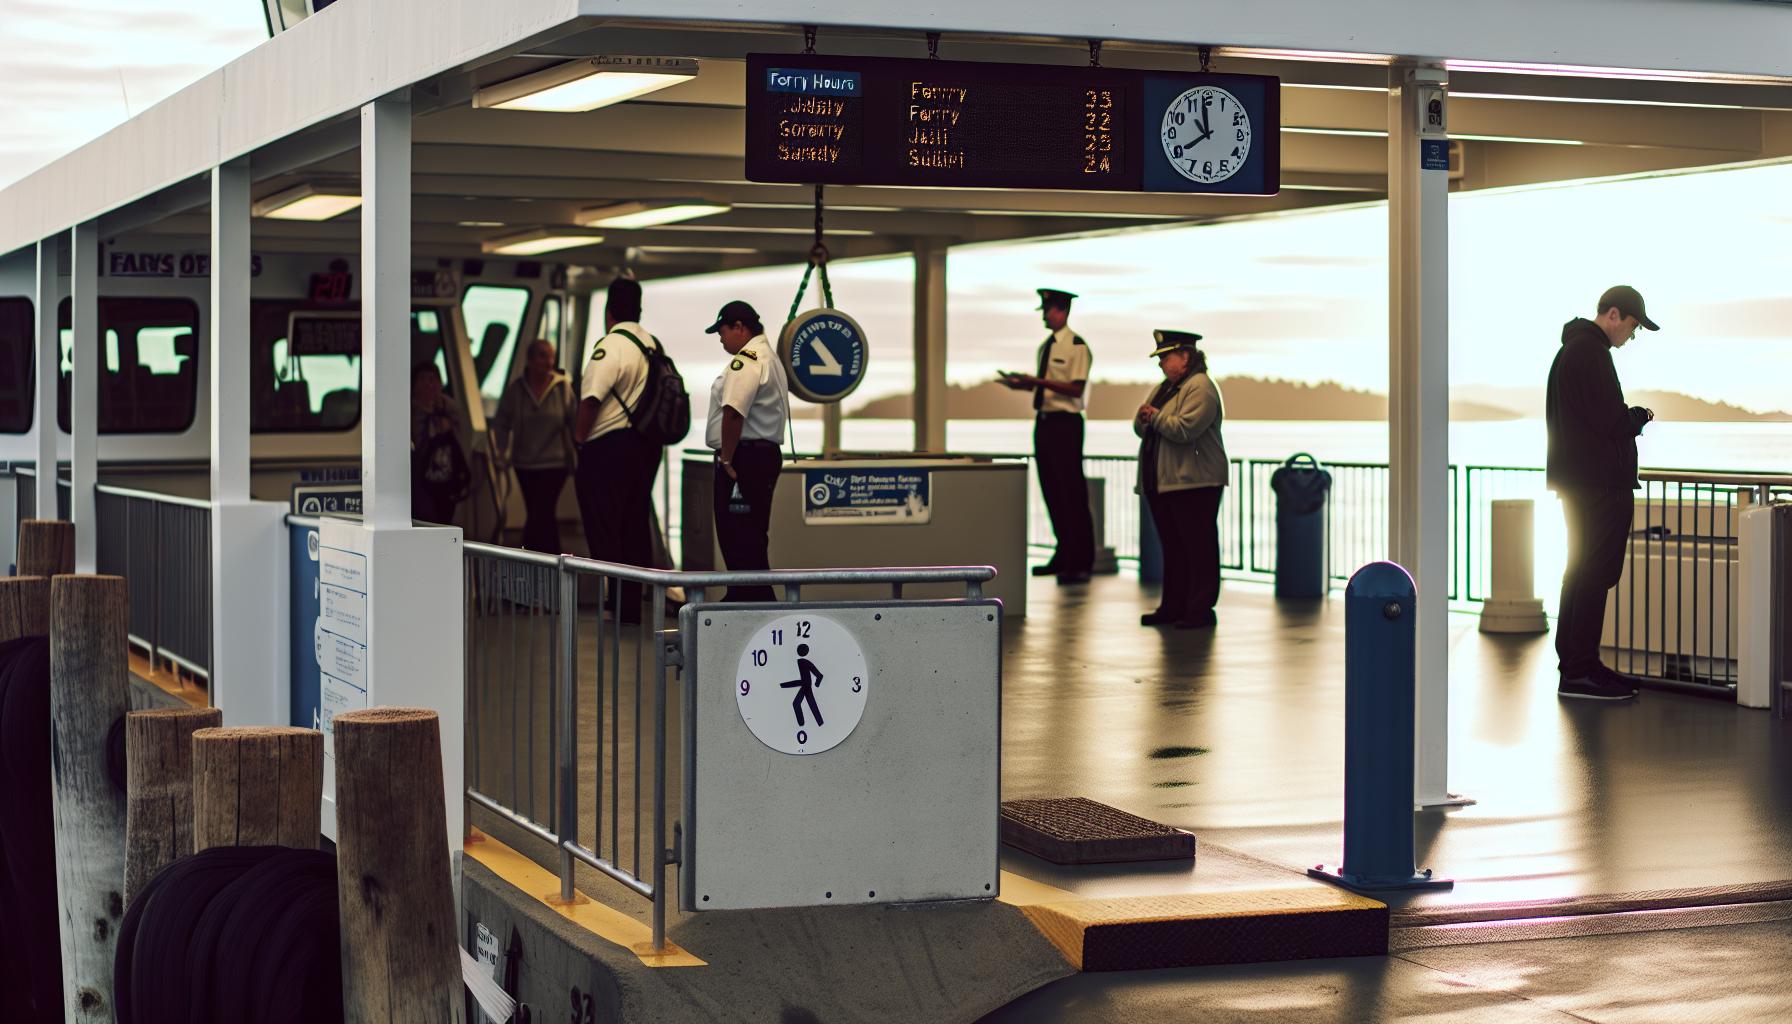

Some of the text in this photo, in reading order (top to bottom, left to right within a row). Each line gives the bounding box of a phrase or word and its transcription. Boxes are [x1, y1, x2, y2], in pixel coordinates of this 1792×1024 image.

[771, 629, 783, 646] 11
[796, 620, 812, 639] 12
[751, 649, 768, 667] 10
[740, 679, 750, 696] 9
[852, 676, 862, 693] 3
